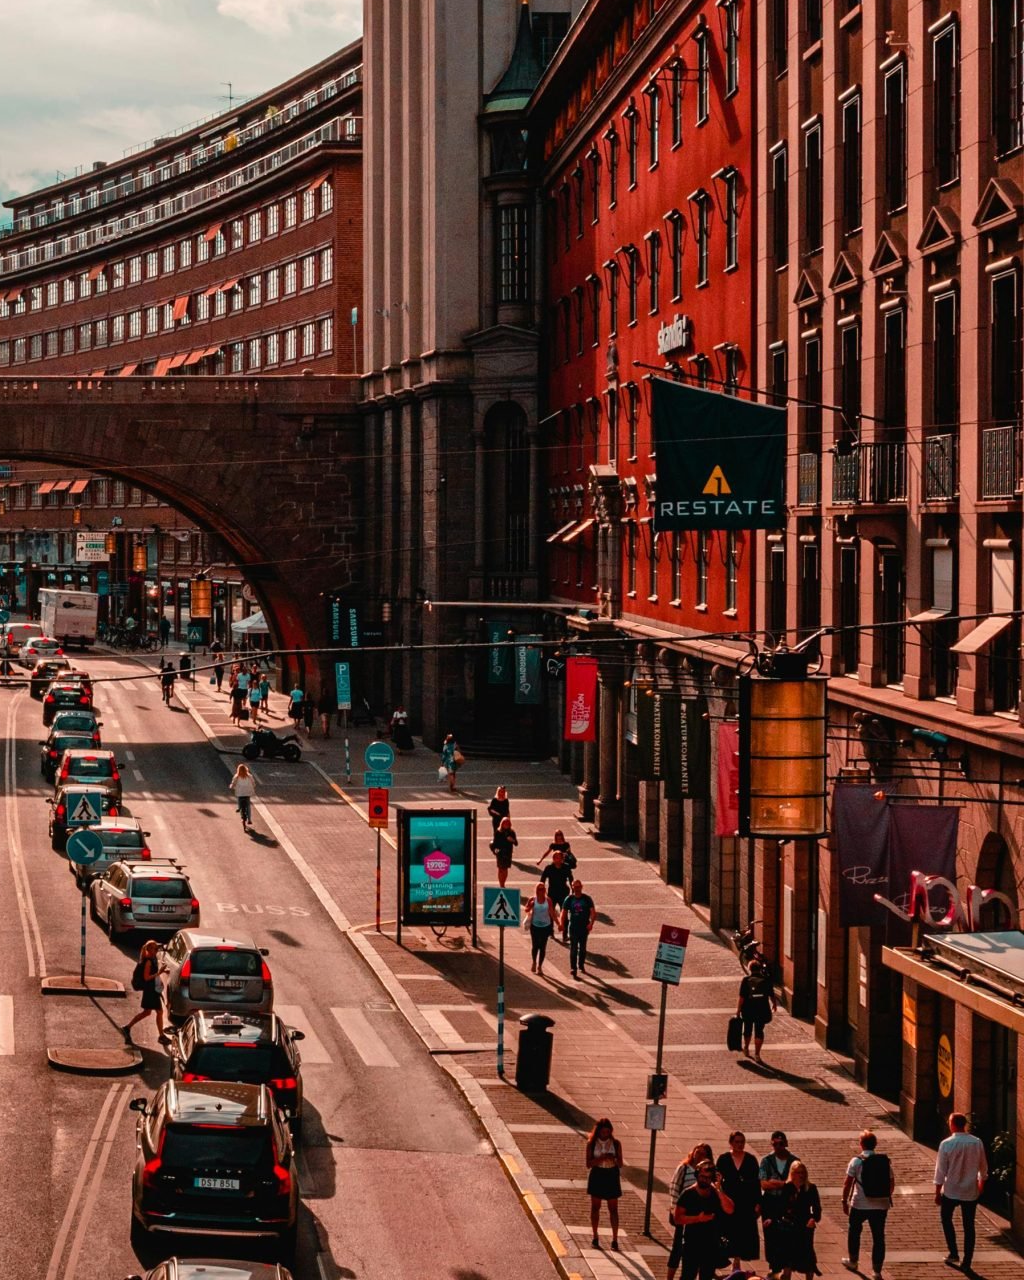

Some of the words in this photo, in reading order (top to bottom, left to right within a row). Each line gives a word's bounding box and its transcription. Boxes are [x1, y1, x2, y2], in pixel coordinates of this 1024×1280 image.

[660, 499, 775, 517] RESTATE
[332, 602, 340, 640] SAMSUNG
[349, 608, 359, 647] SAMSUNG
[339, 664, 347, 675] P
[653, 701, 661, 776] NATURKOMPANIET
[680, 713, 689, 794] NATURKOMPANIET
[420, 882, 453, 890] Kryssning
[216, 902, 311, 917] BUSS
[201, 1178, 217, 1187] DST
